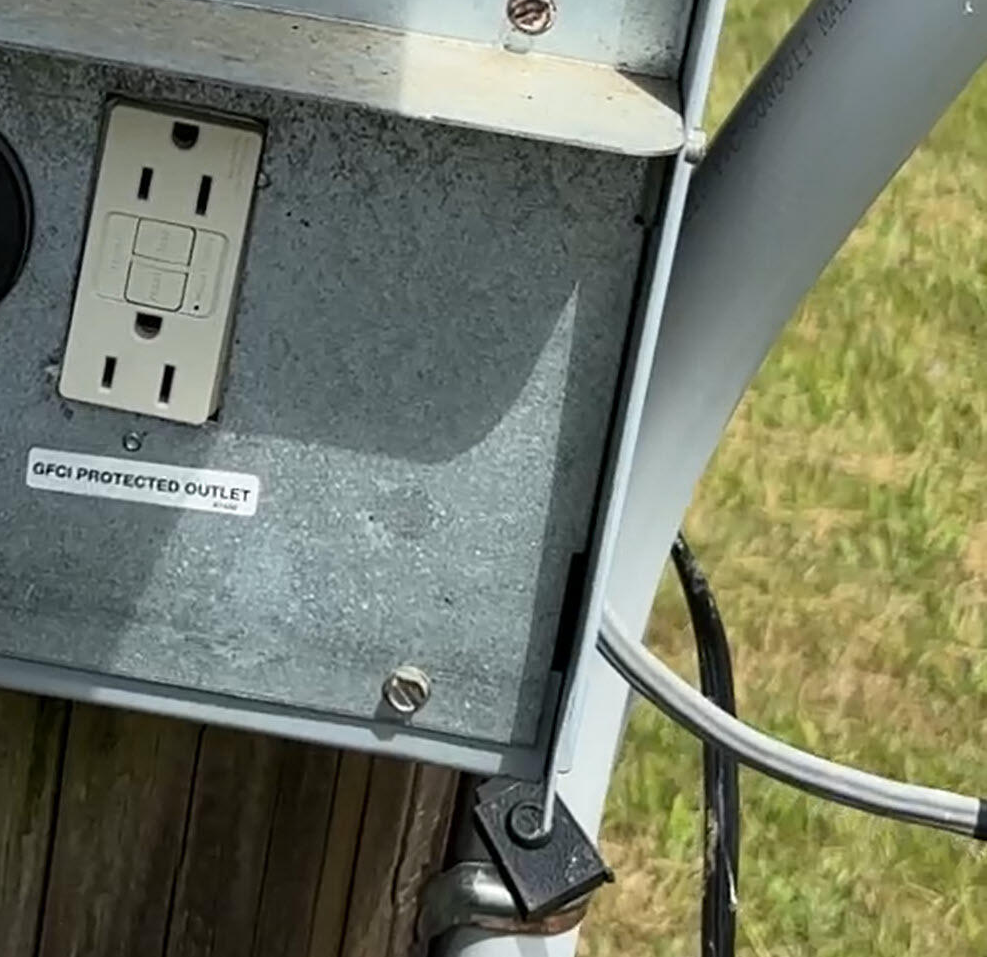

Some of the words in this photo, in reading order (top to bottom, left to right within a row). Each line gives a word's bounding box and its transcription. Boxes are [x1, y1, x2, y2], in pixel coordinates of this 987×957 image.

[32, 461, 73, 479] GFCI
[76, 467, 180, 493] PROTECTED
[184, 481, 251, 503] OUTLET
